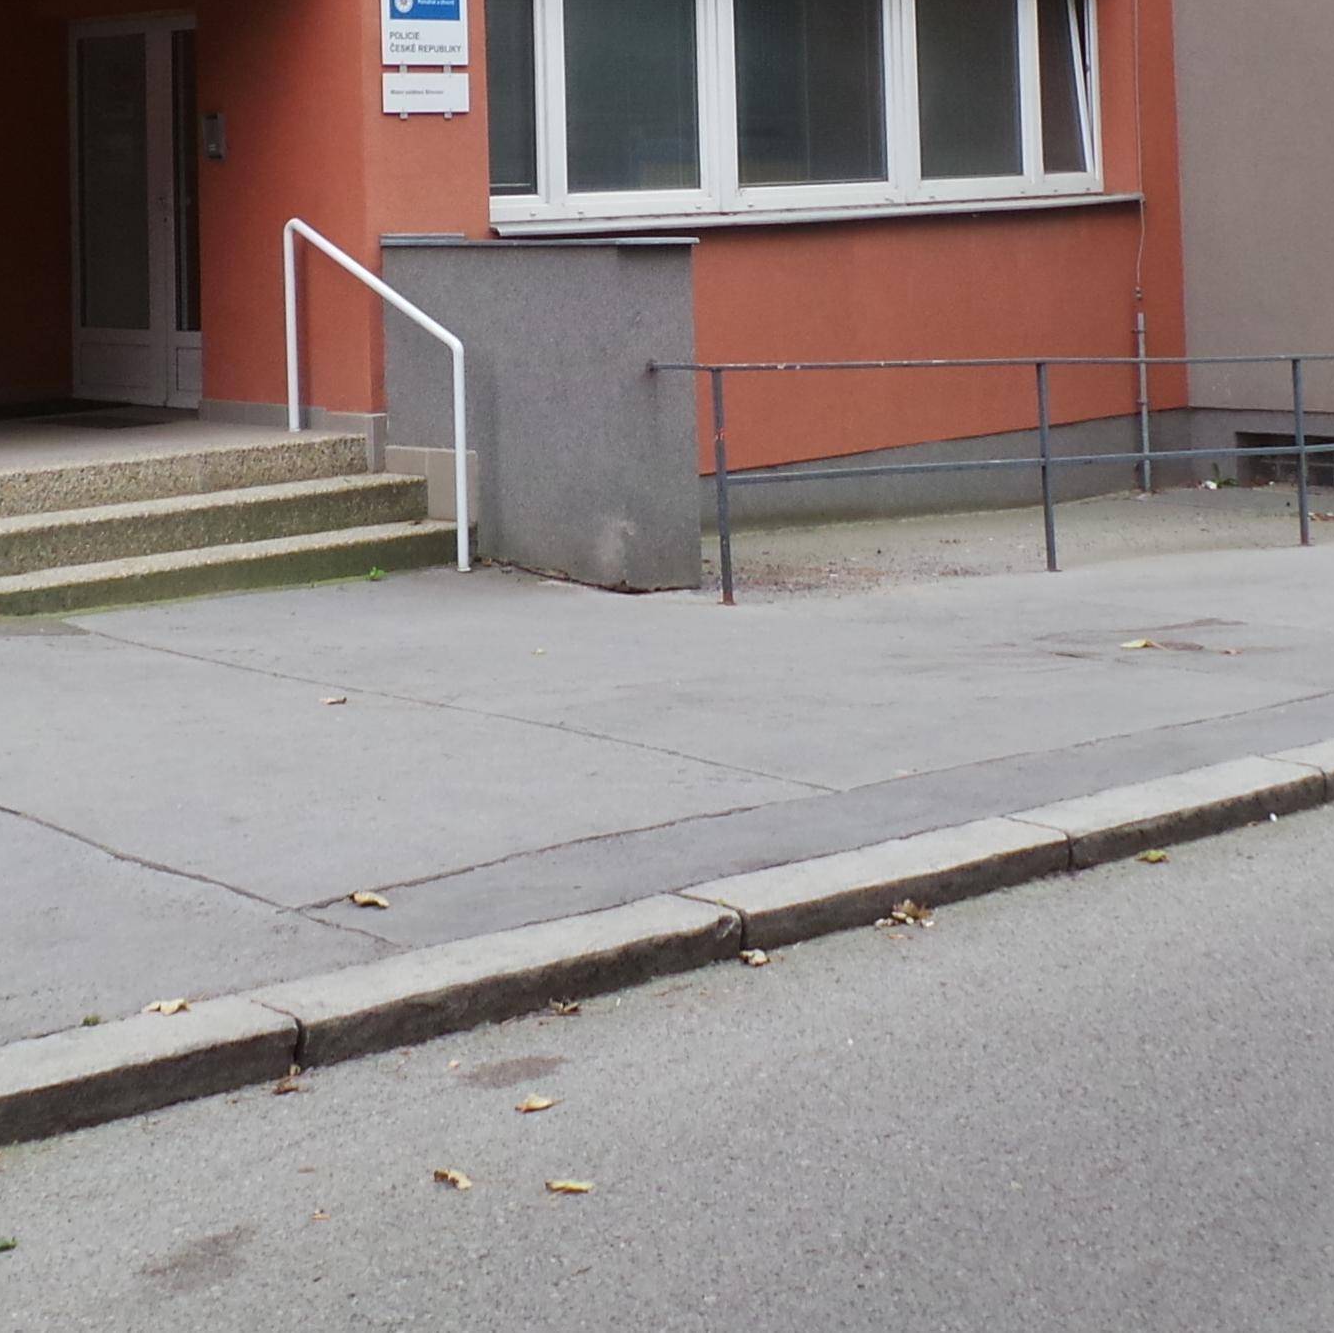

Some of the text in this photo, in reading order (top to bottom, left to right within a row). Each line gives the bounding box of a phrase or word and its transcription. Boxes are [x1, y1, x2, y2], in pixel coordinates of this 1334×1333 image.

[389, 31, 419, 40] POLICIE
[389, 43, 462, 53] ČESKÉ REPUBLIKY
